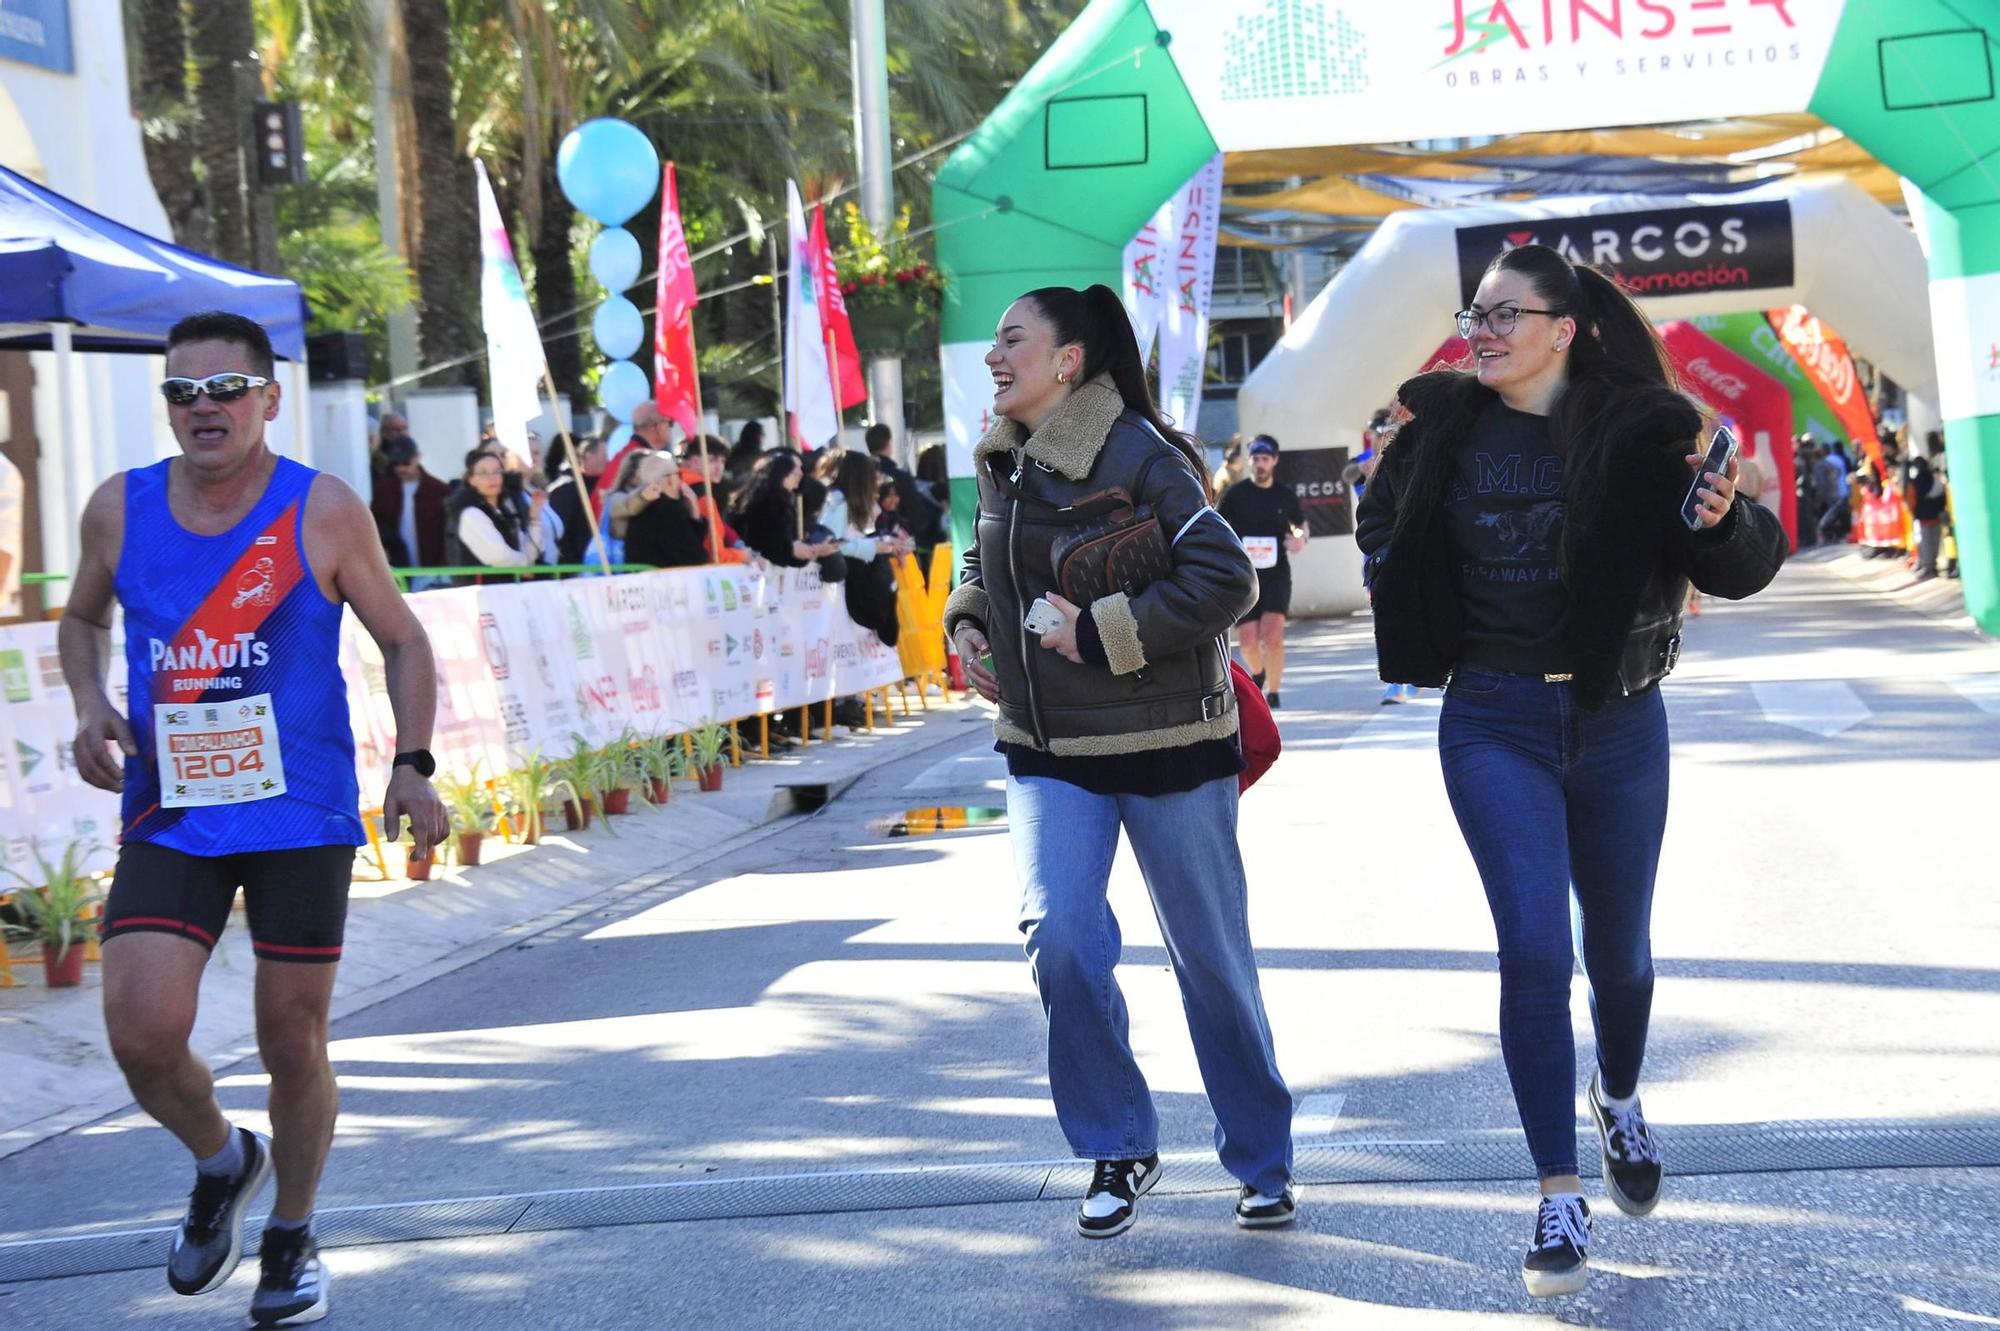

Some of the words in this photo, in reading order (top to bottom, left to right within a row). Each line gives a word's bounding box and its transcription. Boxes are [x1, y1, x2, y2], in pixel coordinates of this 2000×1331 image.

[1445, 65, 1550, 88] OBRAS
[1577, 61, 1588, 78] Y
[1615, 43, 1801, 76] SERVICIOS
[1179, 187, 1202, 316] JAINSE
[1615, 262, 1749, 293] tomoción
[1296, 480, 1345, 497] RCOS
[173, 676, 243, 692] RUNNING
[172, 749, 265, 781] 1204
